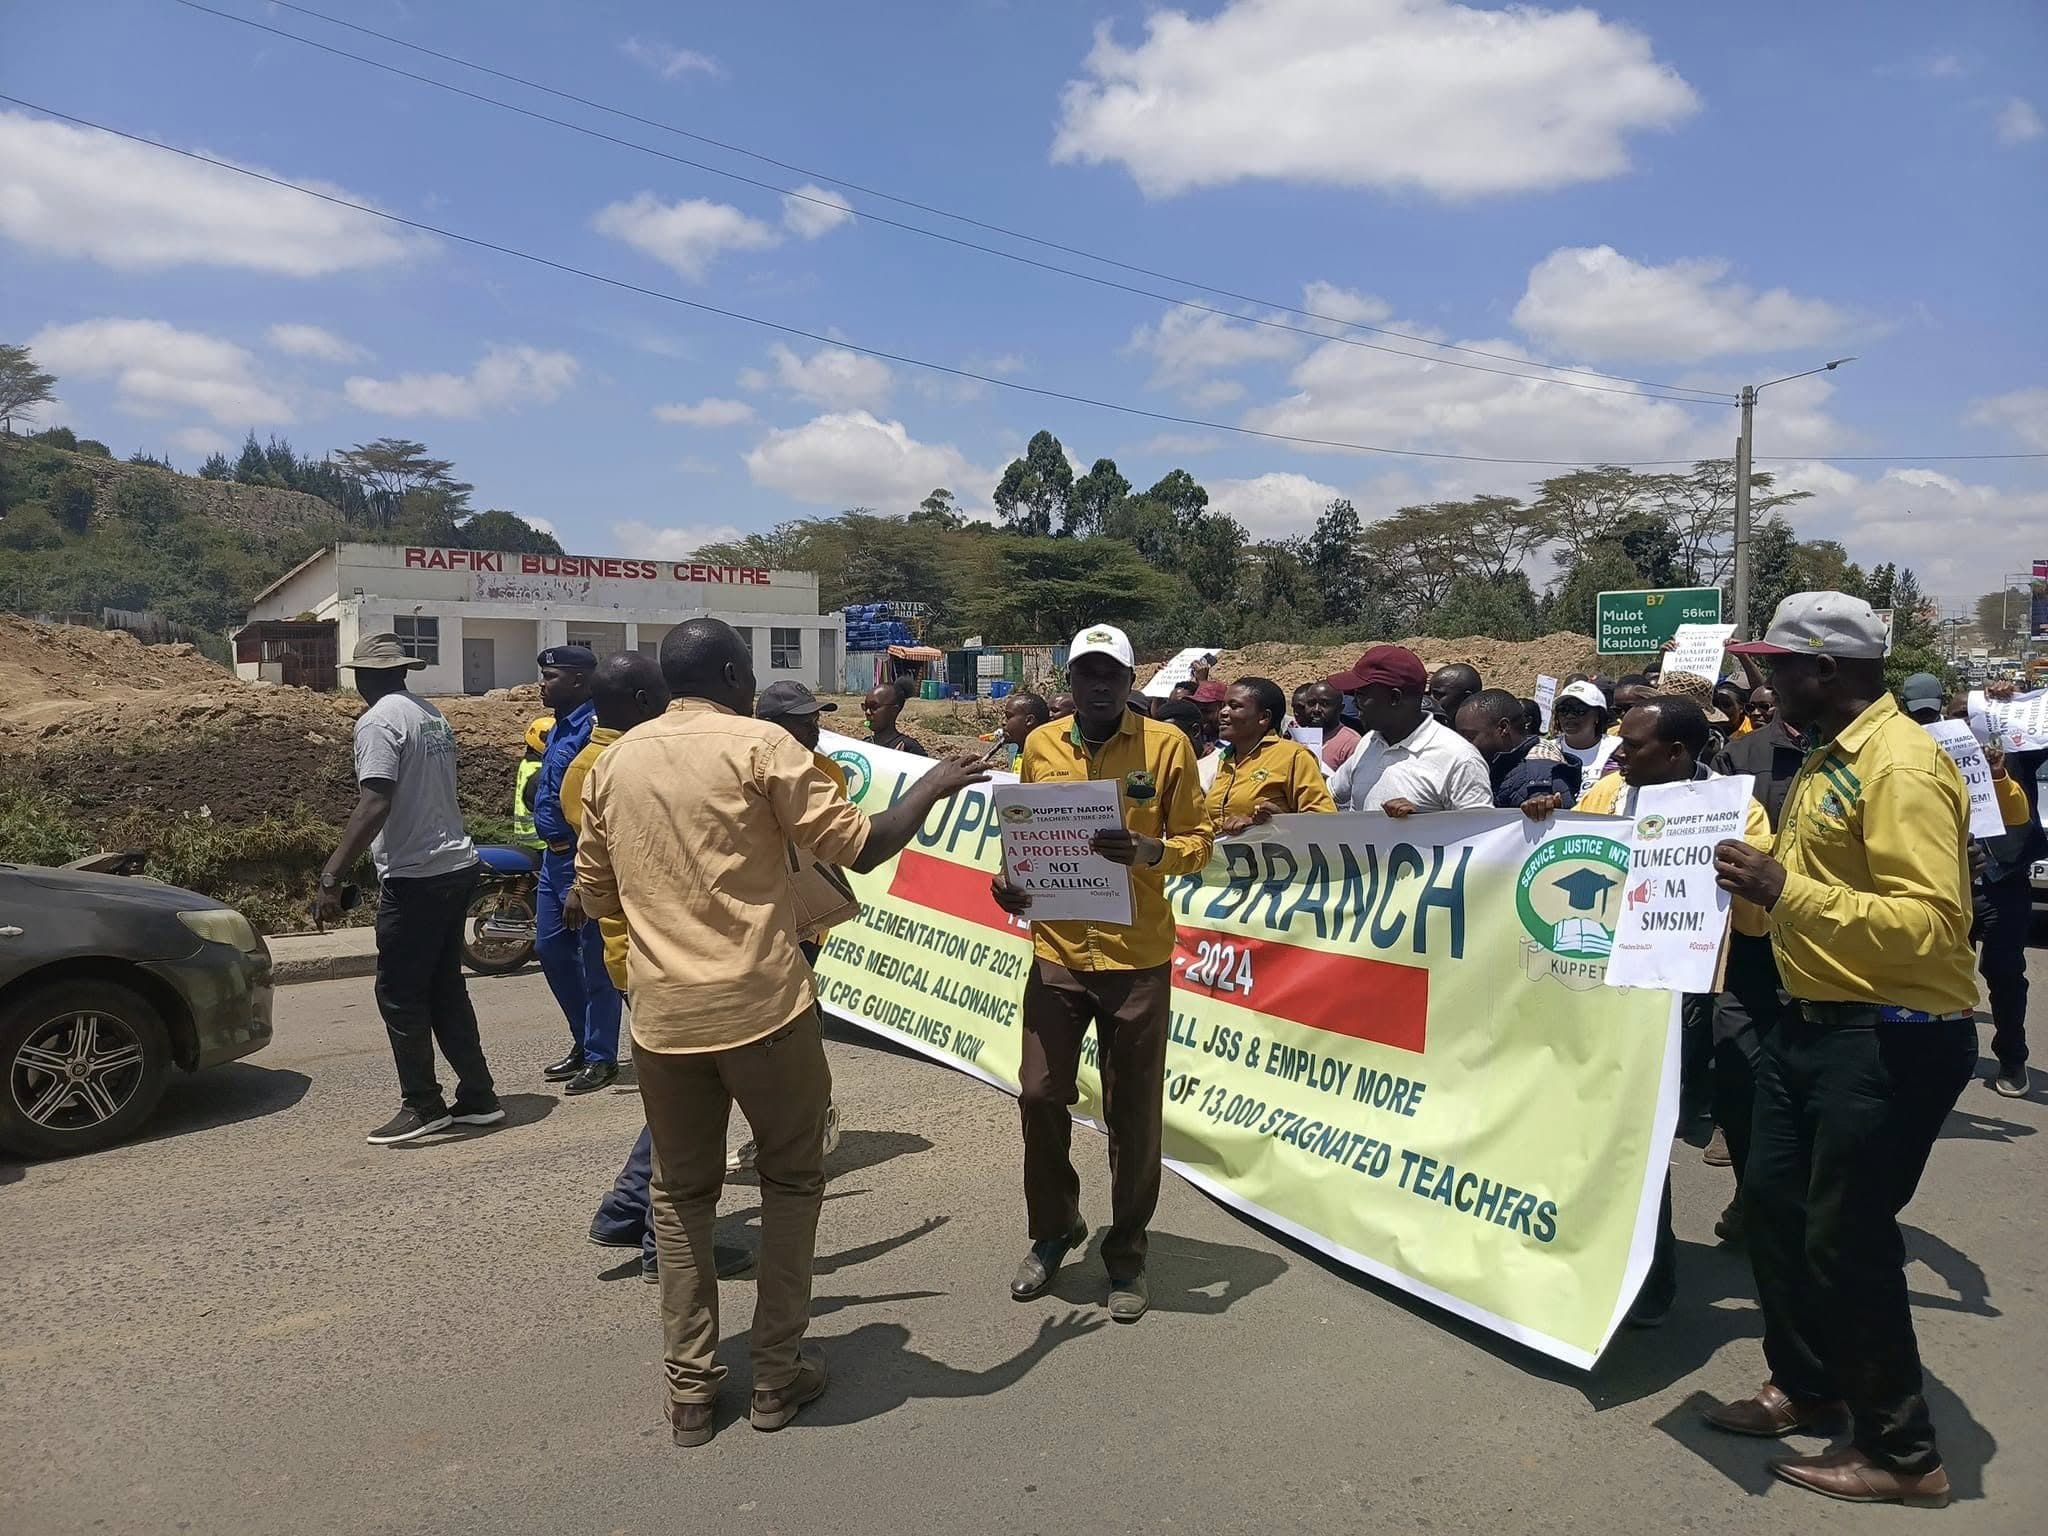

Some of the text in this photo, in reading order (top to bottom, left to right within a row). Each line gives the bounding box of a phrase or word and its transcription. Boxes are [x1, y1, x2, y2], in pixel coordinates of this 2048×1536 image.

[405, 547, 771, 585] RAFIKI BUSINESS CENTRE
[1646, 594, 1665, 606] B7
[1603, 608, 1716, 621] Mulot 56km
[1602, 624, 1648, 635] Bomet
[1602, 637, 1659, 650] Kaplong
[1032, 805, 1114, 815] KUPPET NAROK
[1666, 811, 1740, 826] KUPPET NAROK
[1010, 829, 1090, 842] TEACHING
[1007, 846, 1018, 857] A
[1049, 862, 1080, 873] NOT
[1521, 844, 1556, 888] SERVICE
[1562, 838, 1604, 855] JUSTICE
[1025, 877, 1110, 888] A CALLING!
[1664, 879, 1687, 898] NA
[1204, 842, 1474, 960] BRANCH
[1640, 912, 1705, 931] SIMSIM!
[969, 943, 991, 968] OF
[989, 949, 1023, 981] 2021
[1185, 941, 1254, 996] 2024
[1551, 959, 1606, 980] KUPPET
[865, 949, 930, 993] MEDICAL
[930, 975, 1018, 1028] ALLOWANCE
[830, 980, 862, 1010] CPG
[862, 994, 951, 1048] GUIDELINES
[951, 1030, 985, 1062] NOW
[1203, 1024, 1243, 1062] JSS
[1245, 1036, 1261, 1068] &
[1265, 1042, 1353, 1096] EMPLOY
[1353, 1066, 1427, 1117] MORE
[1169, 1074, 1200, 1104] OF
[1198, 1084, 1266, 1128] 13,000
[1258, 1108, 1392, 1178] STAGNATED
[1398, 1149, 1558, 1242] TEACHERS
